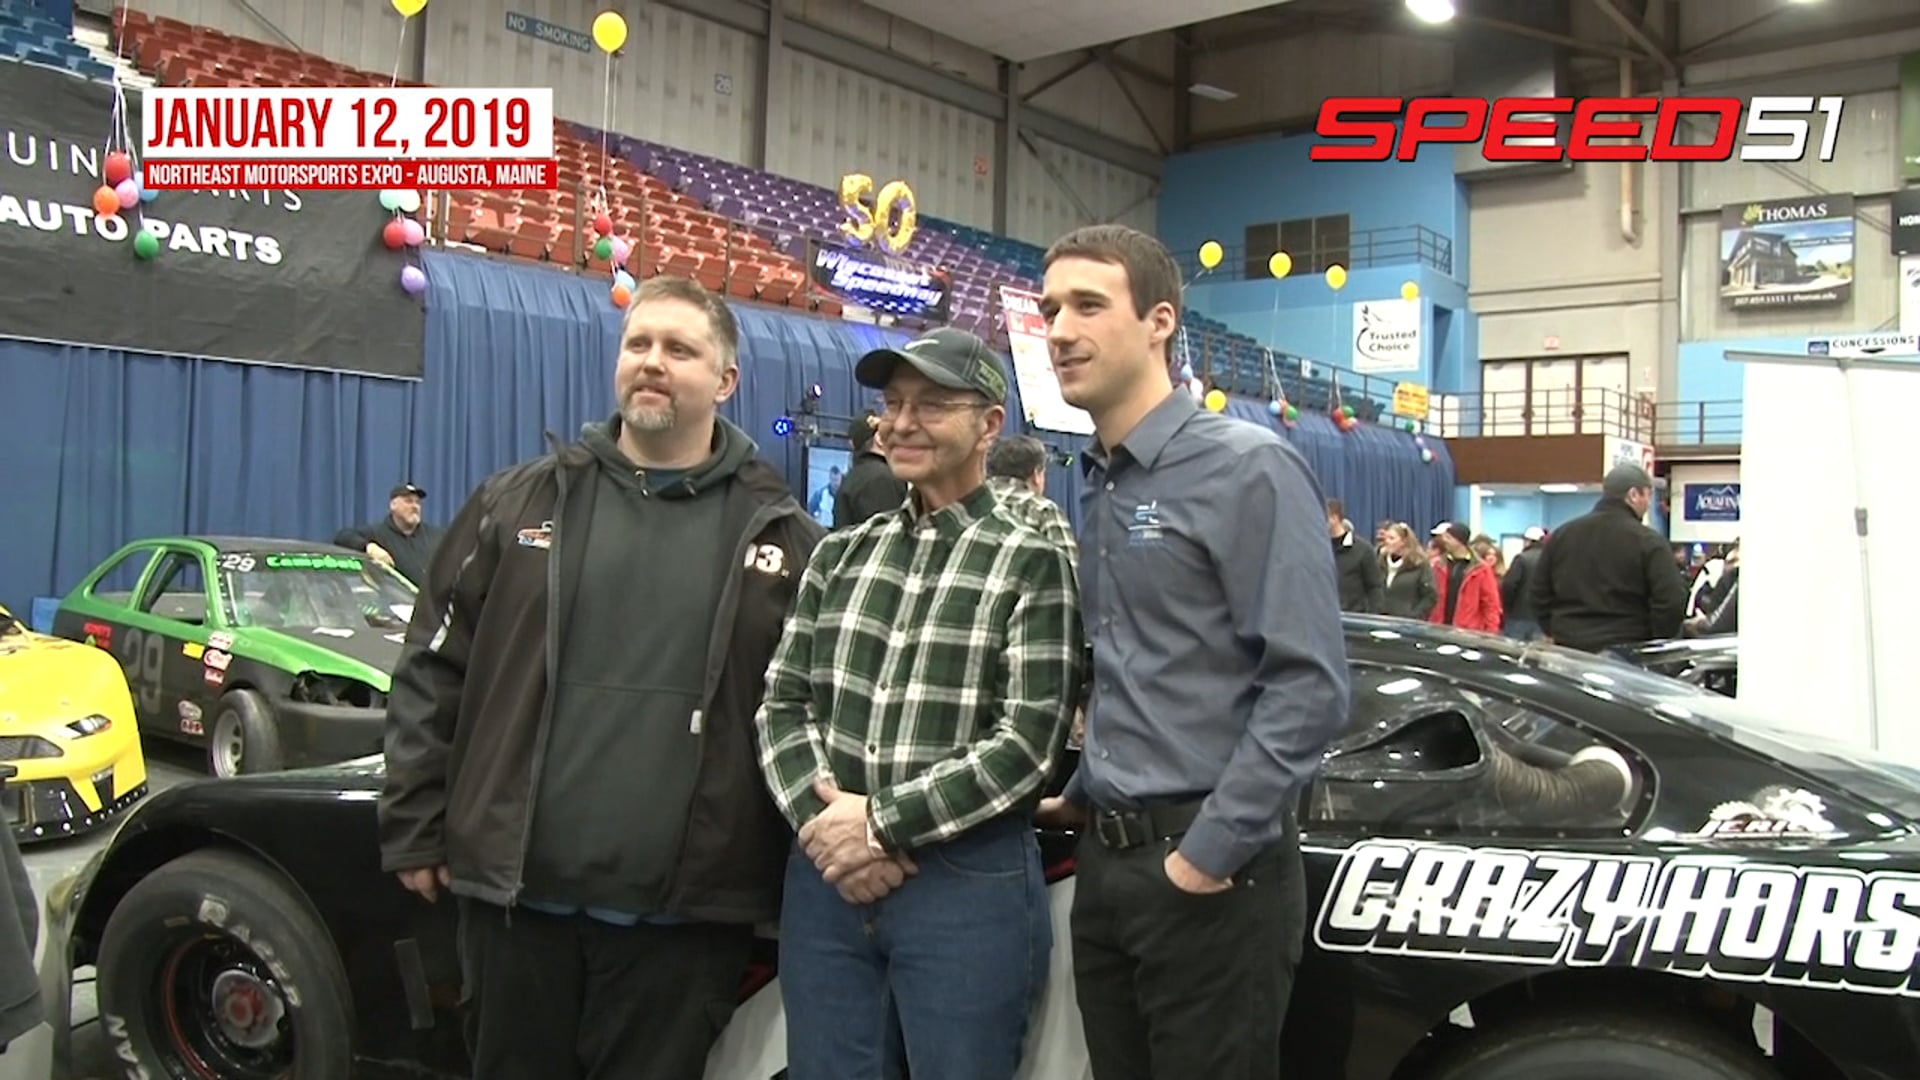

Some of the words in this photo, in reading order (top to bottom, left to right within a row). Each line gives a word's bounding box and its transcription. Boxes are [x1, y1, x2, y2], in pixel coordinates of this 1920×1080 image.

[507, 14, 527, 32] NO
[535, 22, 590, 50] SMOKING
[840, 173, 918, 255] 50
[1757, 202, 1828, 222] THOMAS
[0, 194, 129, 241] AUTO
[141, 217, 283, 265] PARTS
[1368, 342, 1411, 353] Choice
[1369, 329, 1417, 341] Trusted
[1696, 493, 1740, 511] AQUAFIN
[222, 553, 256, 572] 29
[123, 628, 165, 715] 29
[1318, 842, 1659, 962] CRAZY
